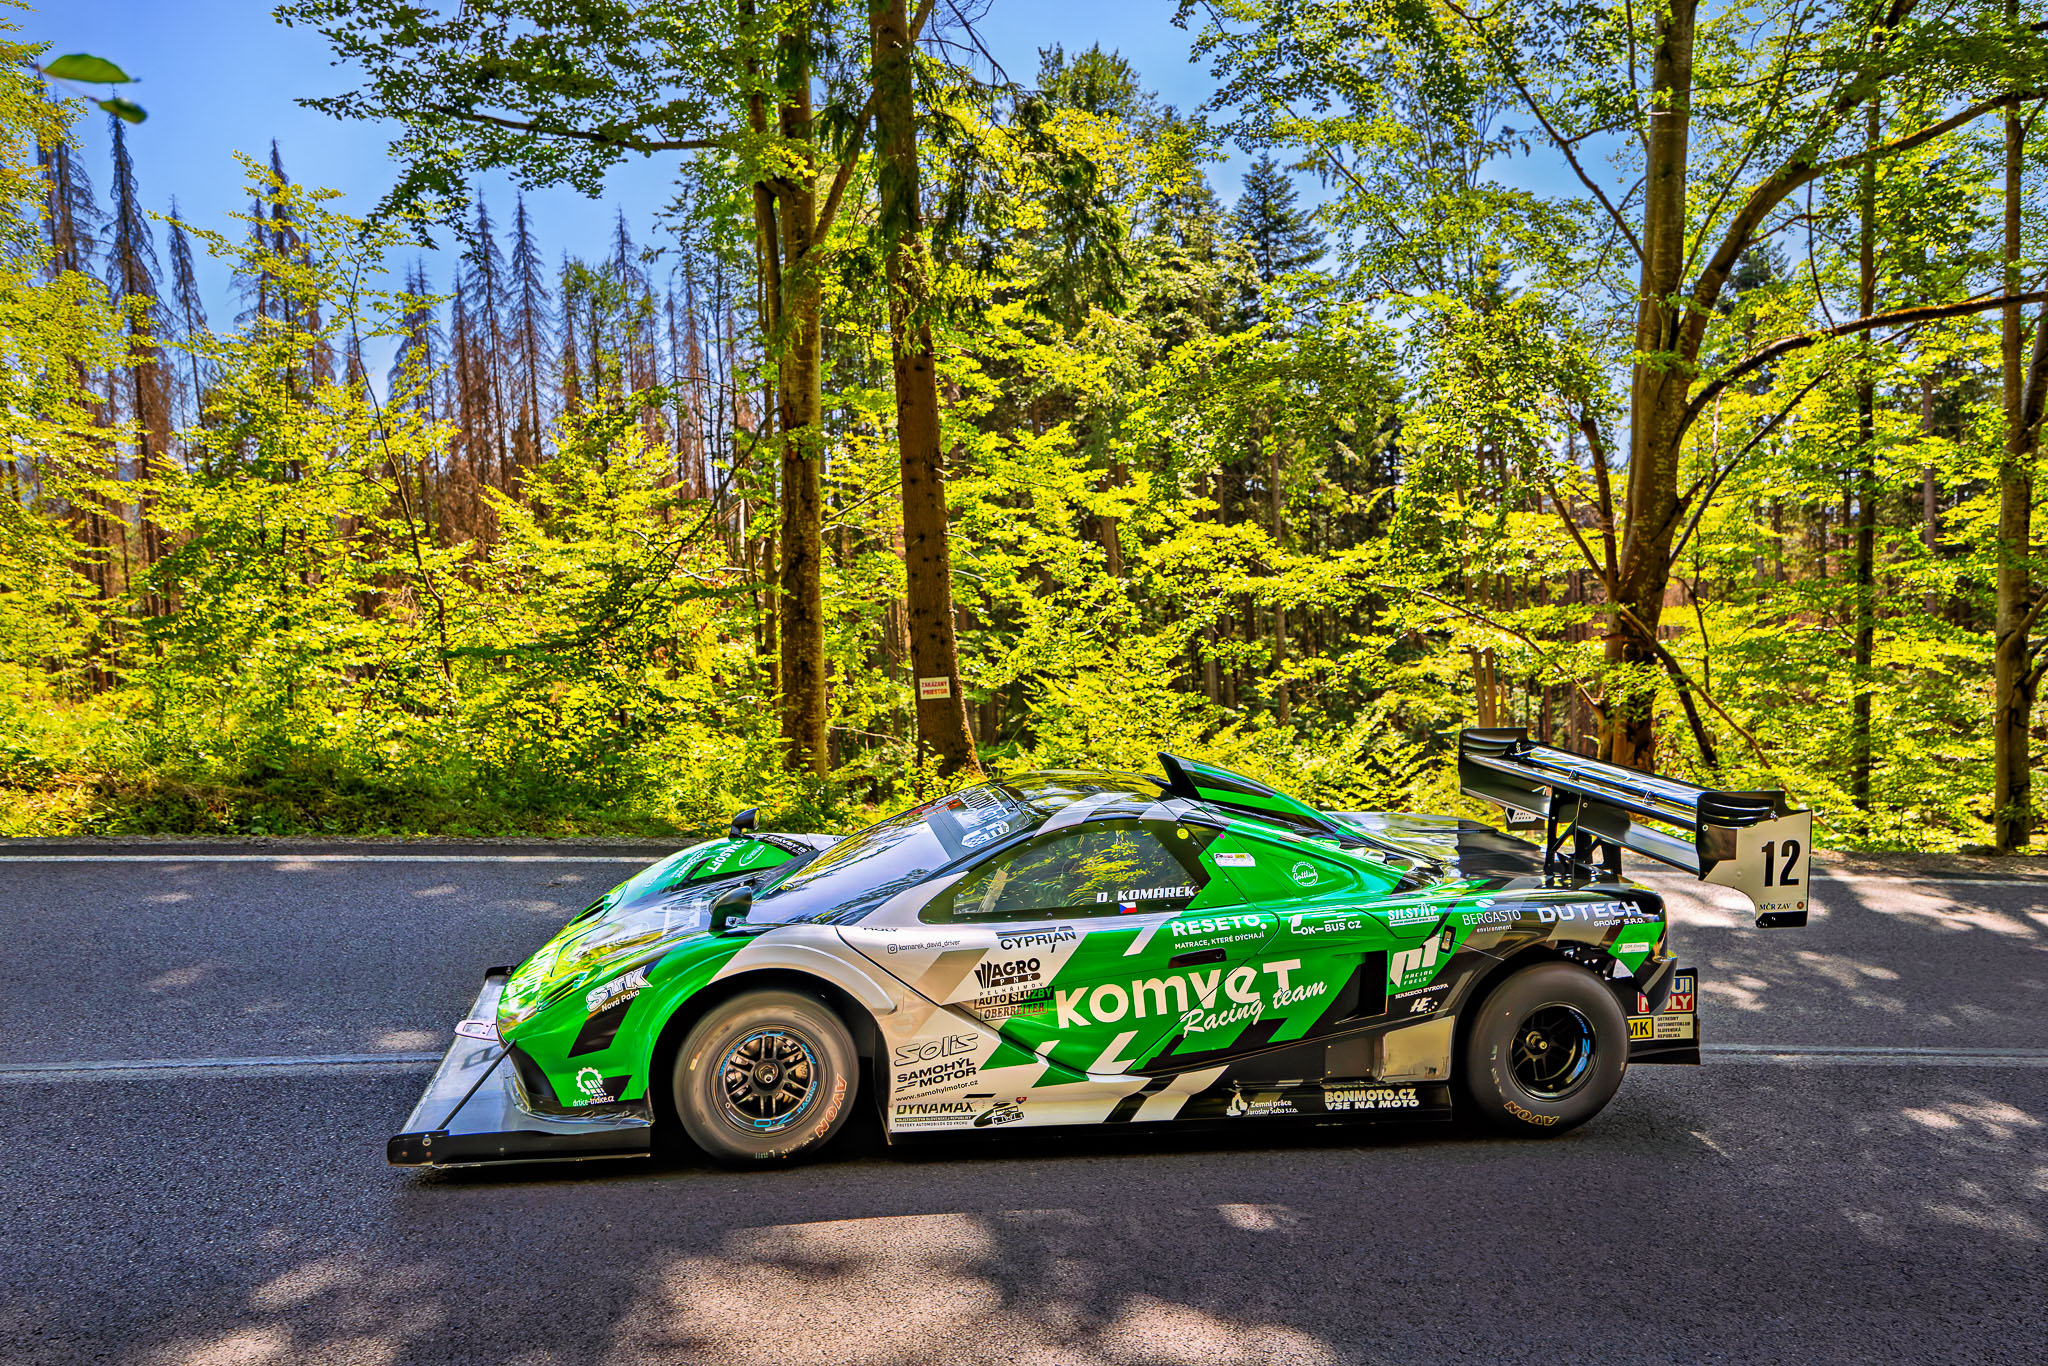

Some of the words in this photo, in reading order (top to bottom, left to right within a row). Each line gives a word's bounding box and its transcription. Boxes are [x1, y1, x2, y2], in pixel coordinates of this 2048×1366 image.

[1761, 840, 1801, 887] 12
[1096, 891, 1113, 903] D.
[1117, 885, 1196, 902] KOMÁREK
[1536, 901, 1642, 923] DUTECH
[1759, 902, 1776, 911] MČR
[1777, 902, 1792, 910] ZAV
[1347, 920, 1363, 930] CZ
[1462, 909, 1521, 925] BERGASTO
[1593, 919, 1621, 927] GROUP
[1623, 917, 1645, 925] S.R.O.
[1476, 924, 1513, 933] environment
[898, 940, 961, 951] komarek_david_driver
[1174, 940, 1210, 950] MATRACE,
[1211, 935, 1234, 944] KTERÉ
[1234, 931, 1265, 942] DÝCHAJÍ
[992, 957, 1041, 979] AGRO
[601, 997, 620, 1012] Nová
[621, 989, 640, 1003] Paka
[979, 993, 1007, 1006] AUTO
[984, 1002, 1045, 1019] OBERREITER
[1180, 997, 1266, 1038] Racing
[1272, 981, 1327, 1010] team
[896, 1058, 975, 1083] SAMOHÝL
[919, 1066, 977, 1088] MOTOR
[895, 1079, 979, 1102] www.samohylmotor.cz
[1324, 1088, 1417, 1103] BONMOTO.CZ
[815, 1072, 848, 1138] AVON
[896, 1102, 973, 1115] DYNAMAX
[1247, 1107, 1270, 1116] Jaroslav
[1250, 1099, 1272, 1108] Zemní
[1273, 1099, 1292, 1108] práce
[1354, 1101, 1375, 1109] NA
[1378, 1099, 1420, 1109] MOTO
[1503, 1100, 1560, 1126] AVON
